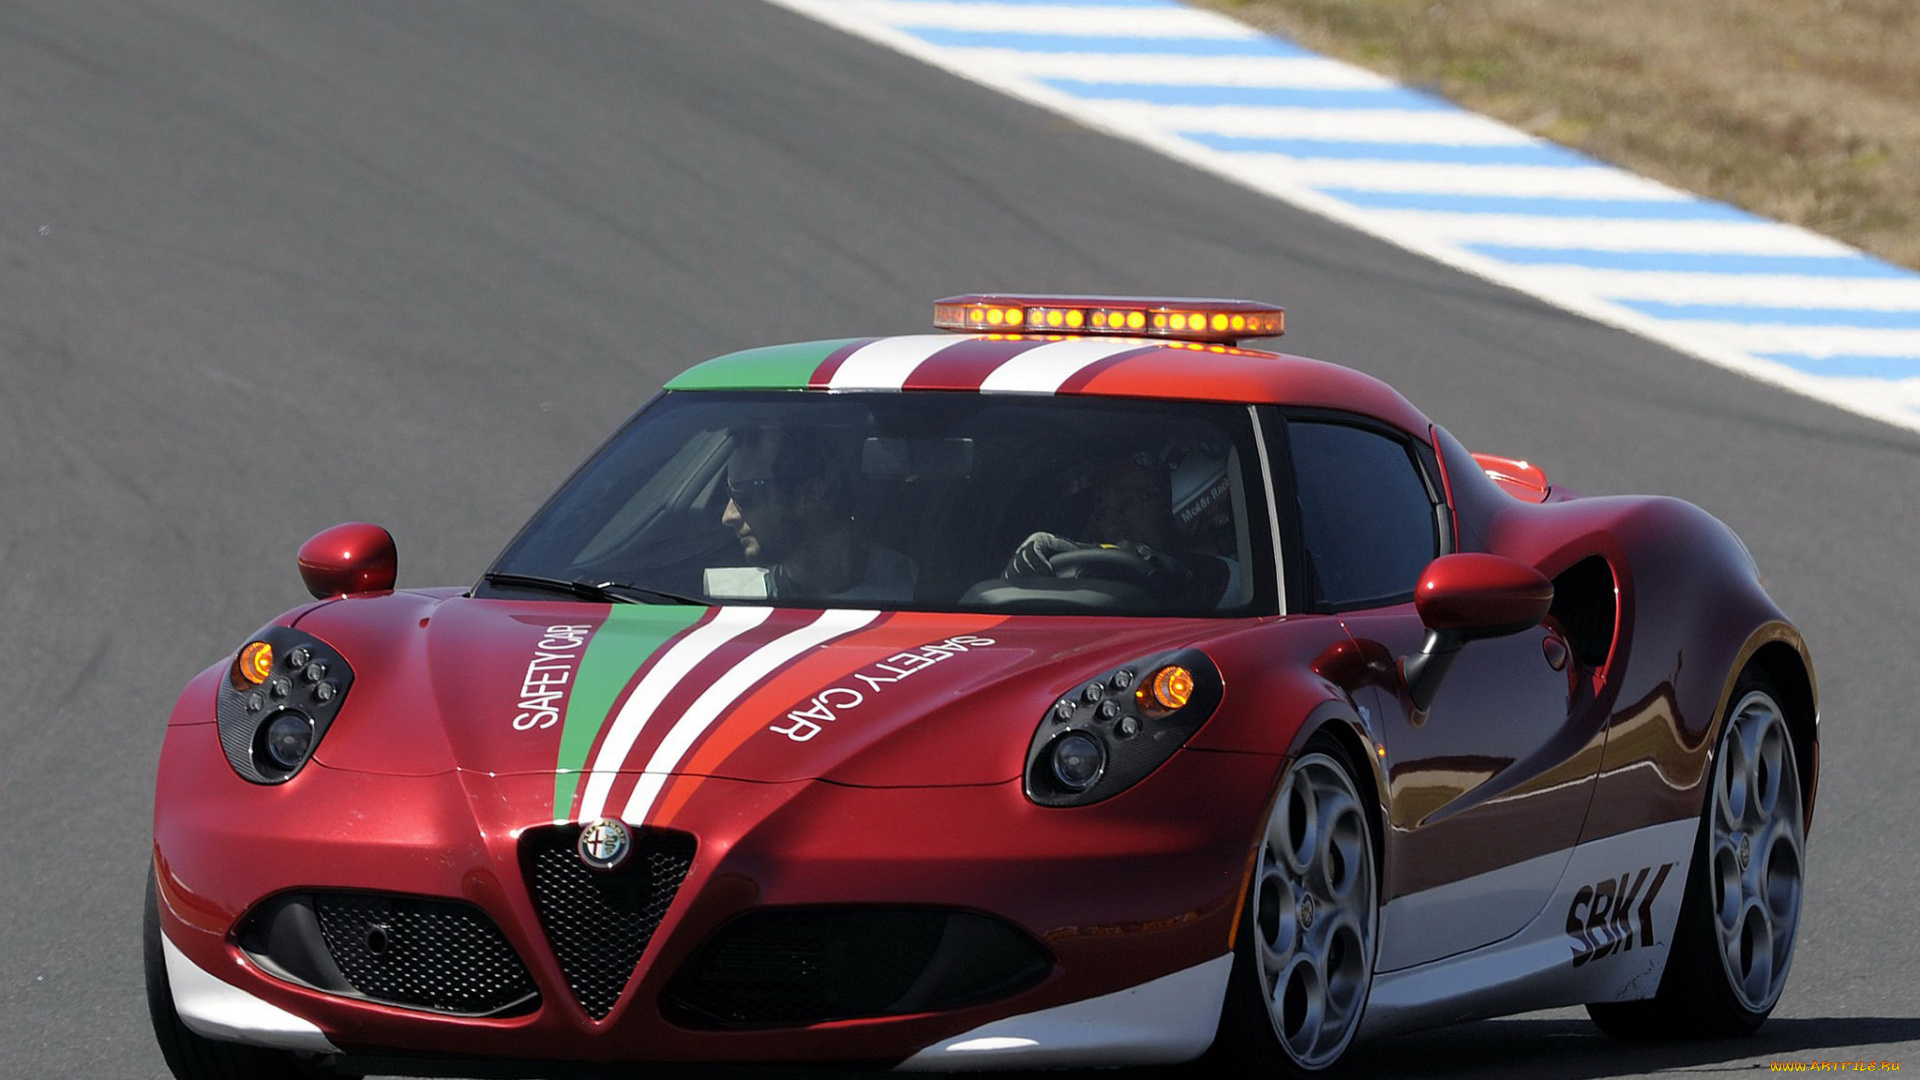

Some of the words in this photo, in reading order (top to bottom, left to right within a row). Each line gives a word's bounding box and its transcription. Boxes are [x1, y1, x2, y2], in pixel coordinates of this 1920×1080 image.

[537, 624, 592, 650] CAR
[854, 635, 996, 692] SAFETY
[512, 651, 575, 731] SAFETY
[769, 687, 863, 742] CAR
